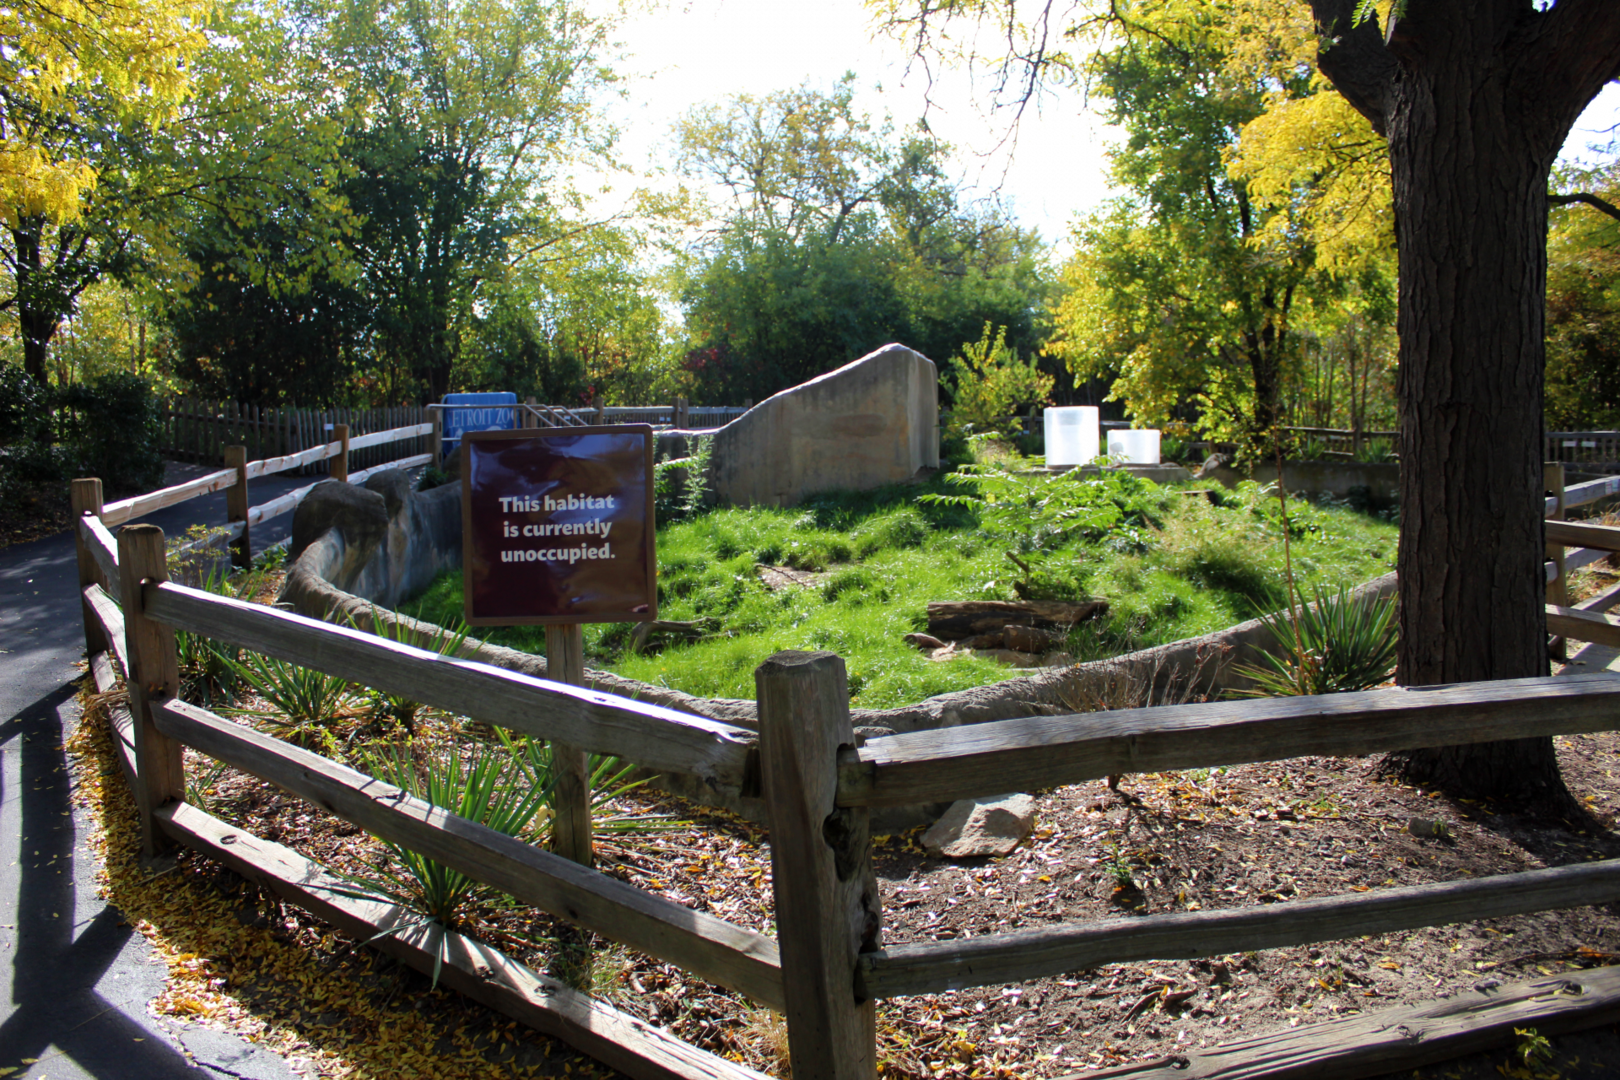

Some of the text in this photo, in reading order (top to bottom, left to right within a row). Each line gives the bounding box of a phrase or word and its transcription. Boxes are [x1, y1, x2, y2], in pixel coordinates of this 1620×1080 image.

[449, 408, 493, 427] ETROIT
[498, 493, 615, 513] This habitat
[503, 518, 613, 539] is currently
[501, 542, 616, 564] unoccupied.
